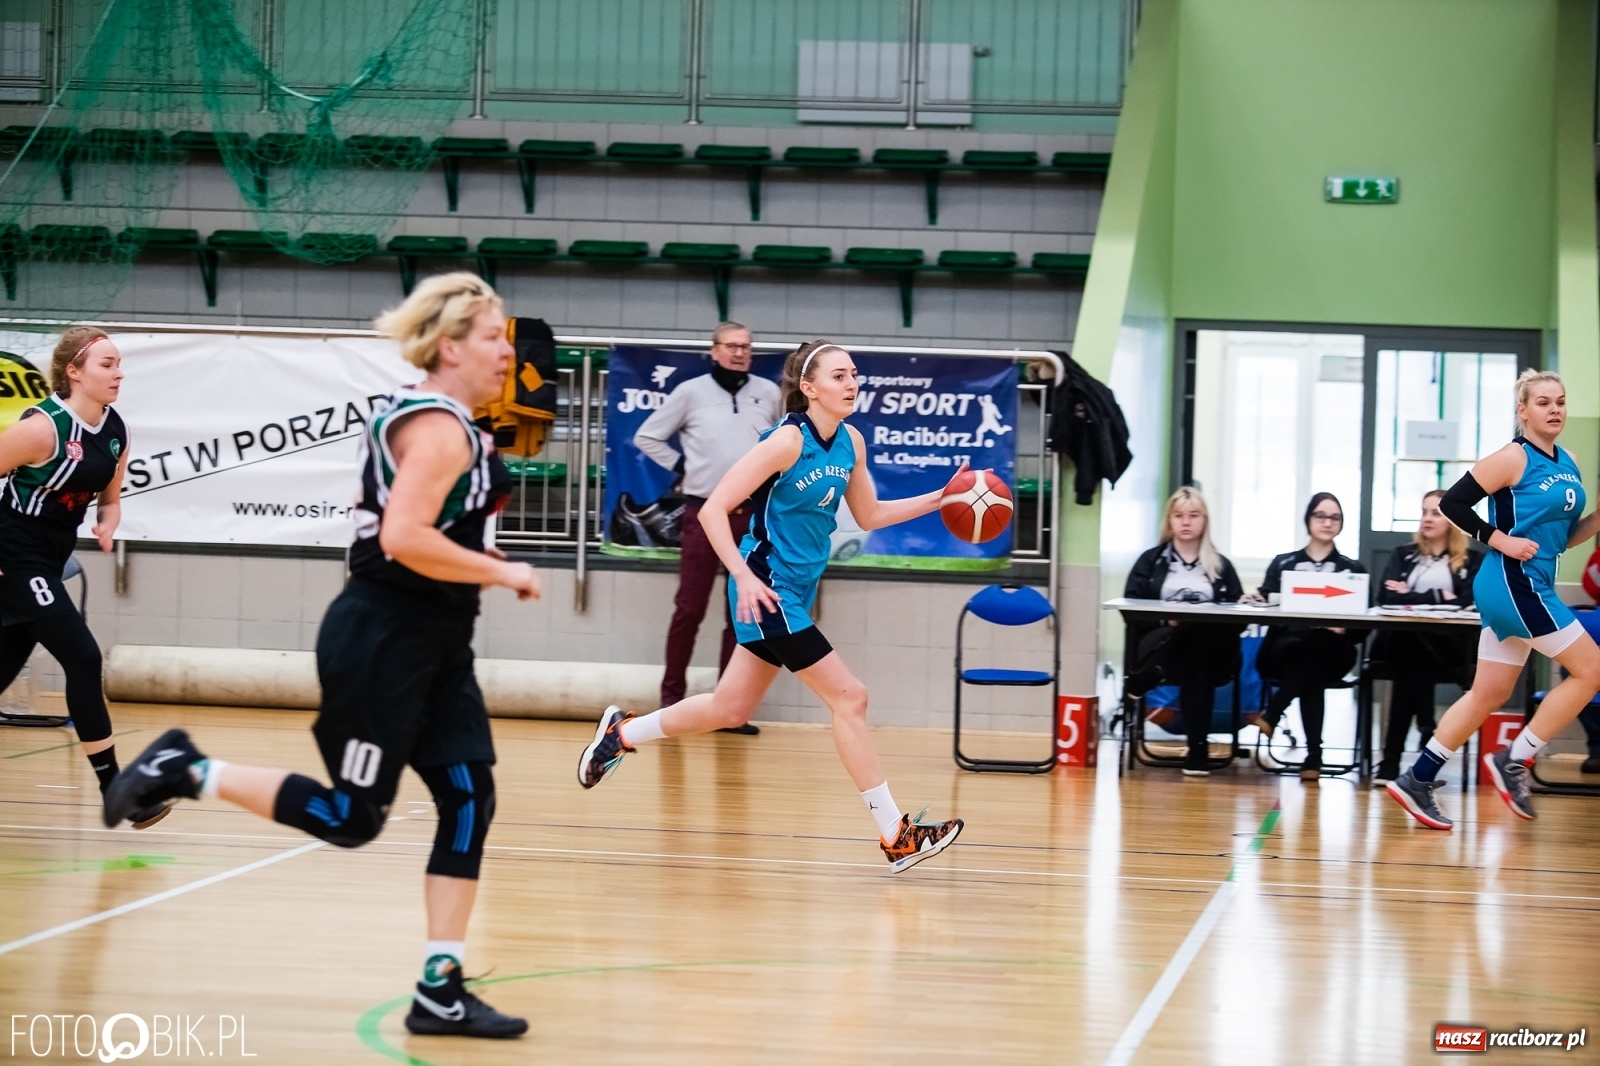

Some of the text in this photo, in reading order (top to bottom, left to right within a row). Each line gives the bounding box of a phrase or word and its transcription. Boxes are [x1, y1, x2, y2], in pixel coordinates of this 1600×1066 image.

[868, 376, 933, 389] sportowy
[880, 392, 975, 416] SPORT
[874, 426, 972, 448] Racibórz
[184, 438, 219, 472] W
[893, 452, 951, 468] Chopina
[953, 455, 971, 466] 17
[795, 468, 823, 492] MLKS
[817, 486, 836, 512] 4
[1563, 488, 1577, 512] 9
[29, 576, 55, 606] 8
[1057, 703, 1082, 749] 5
[340, 738, 383, 788] 10
